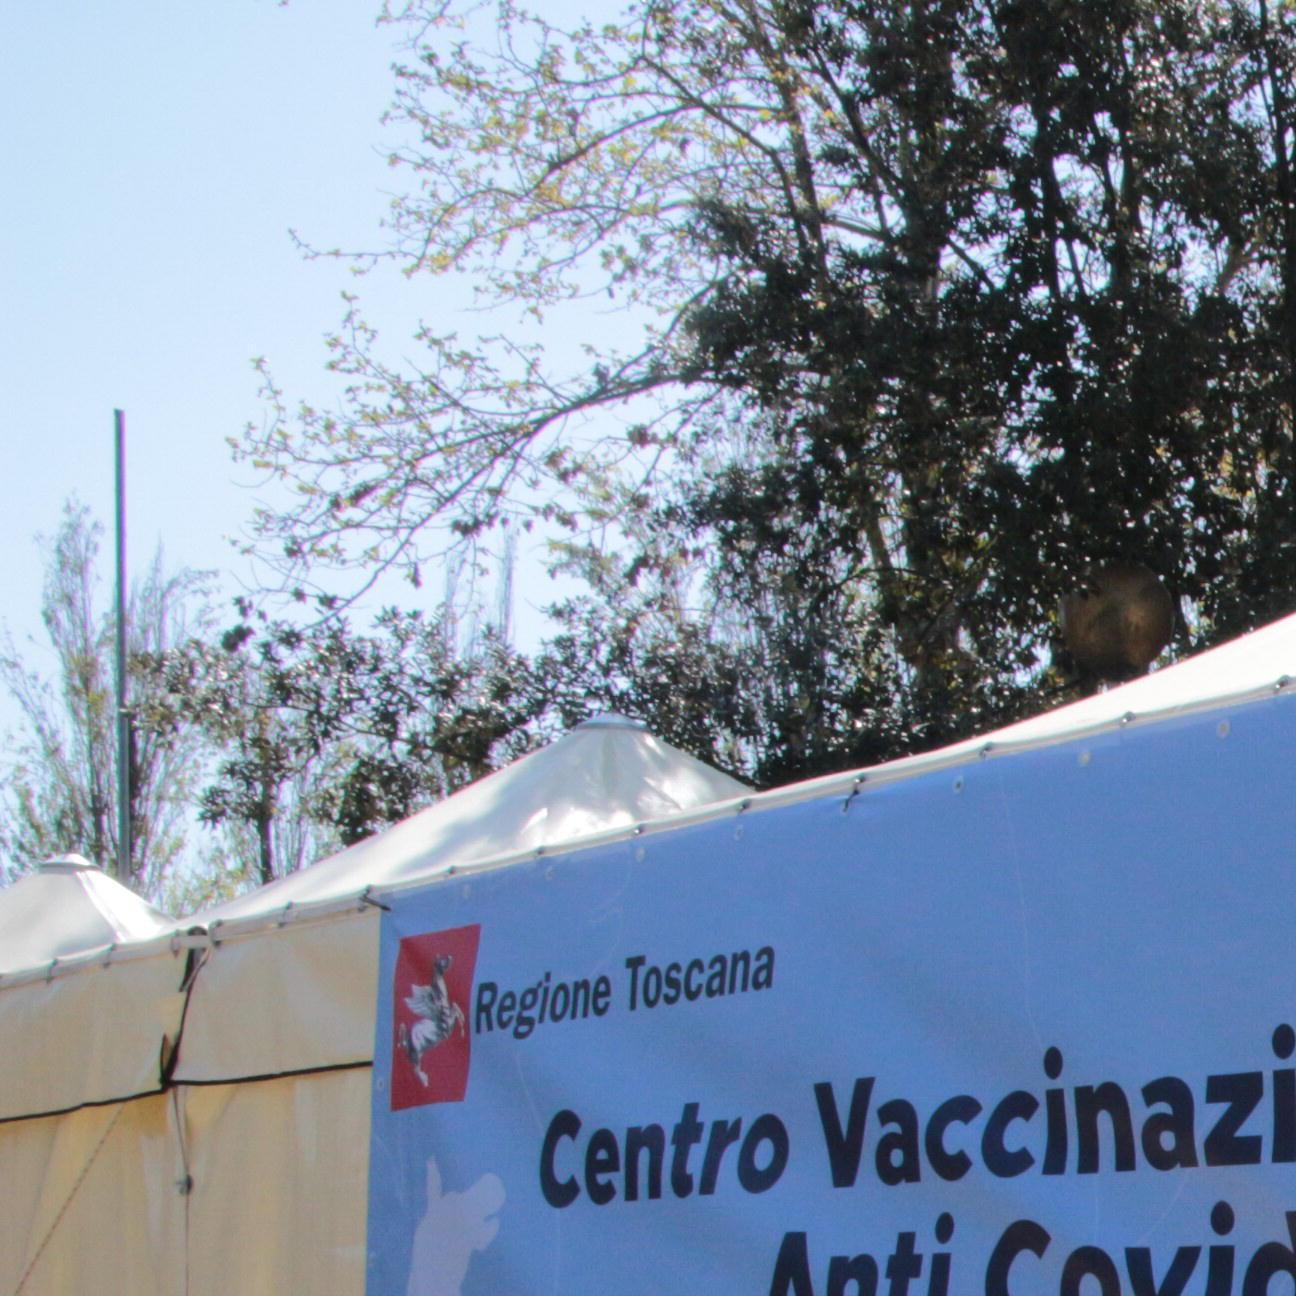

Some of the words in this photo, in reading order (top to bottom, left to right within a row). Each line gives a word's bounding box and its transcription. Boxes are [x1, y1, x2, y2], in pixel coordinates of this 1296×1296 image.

[475, 975, 612, 1040] Regione
[626, 946, 775, 1012] Toscana
[540, 1102, 790, 1209] Centro
